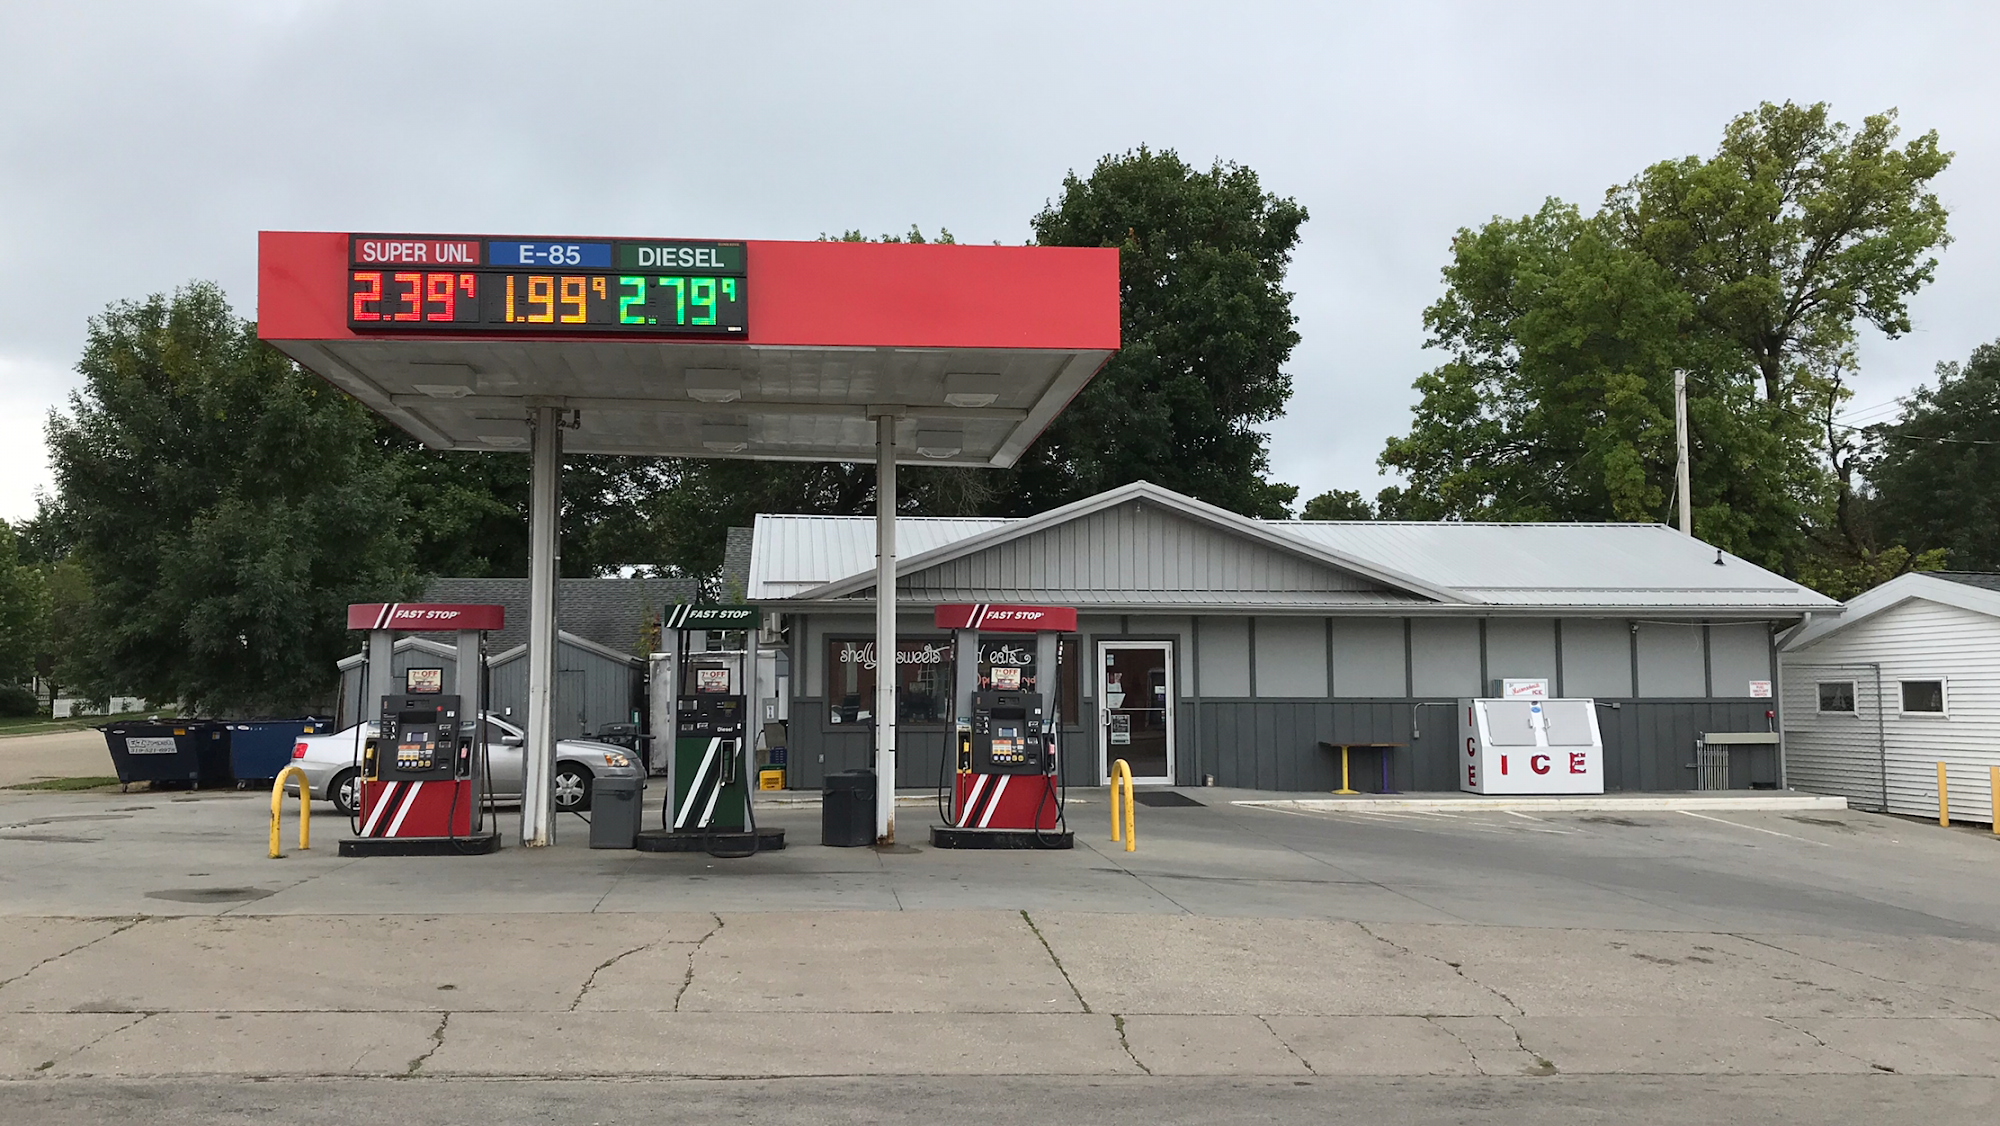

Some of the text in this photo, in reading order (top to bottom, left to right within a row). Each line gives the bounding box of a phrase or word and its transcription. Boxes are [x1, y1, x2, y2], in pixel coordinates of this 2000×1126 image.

[363, 242, 473, 262] SUPER UNL
[519, 245, 581, 265] E-85
[638, 247, 724, 267] DIESEL
[395, 610, 426, 618] FAST
[689, 610, 719, 618] FAST
[986, 611, 1014, 620] FAST
[895, 643, 950, 664] sweets
[990, 644, 1032, 665] eats
[1466, 707, 1477, 787] ICE
[1501, 752, 1587, 776] ICE
